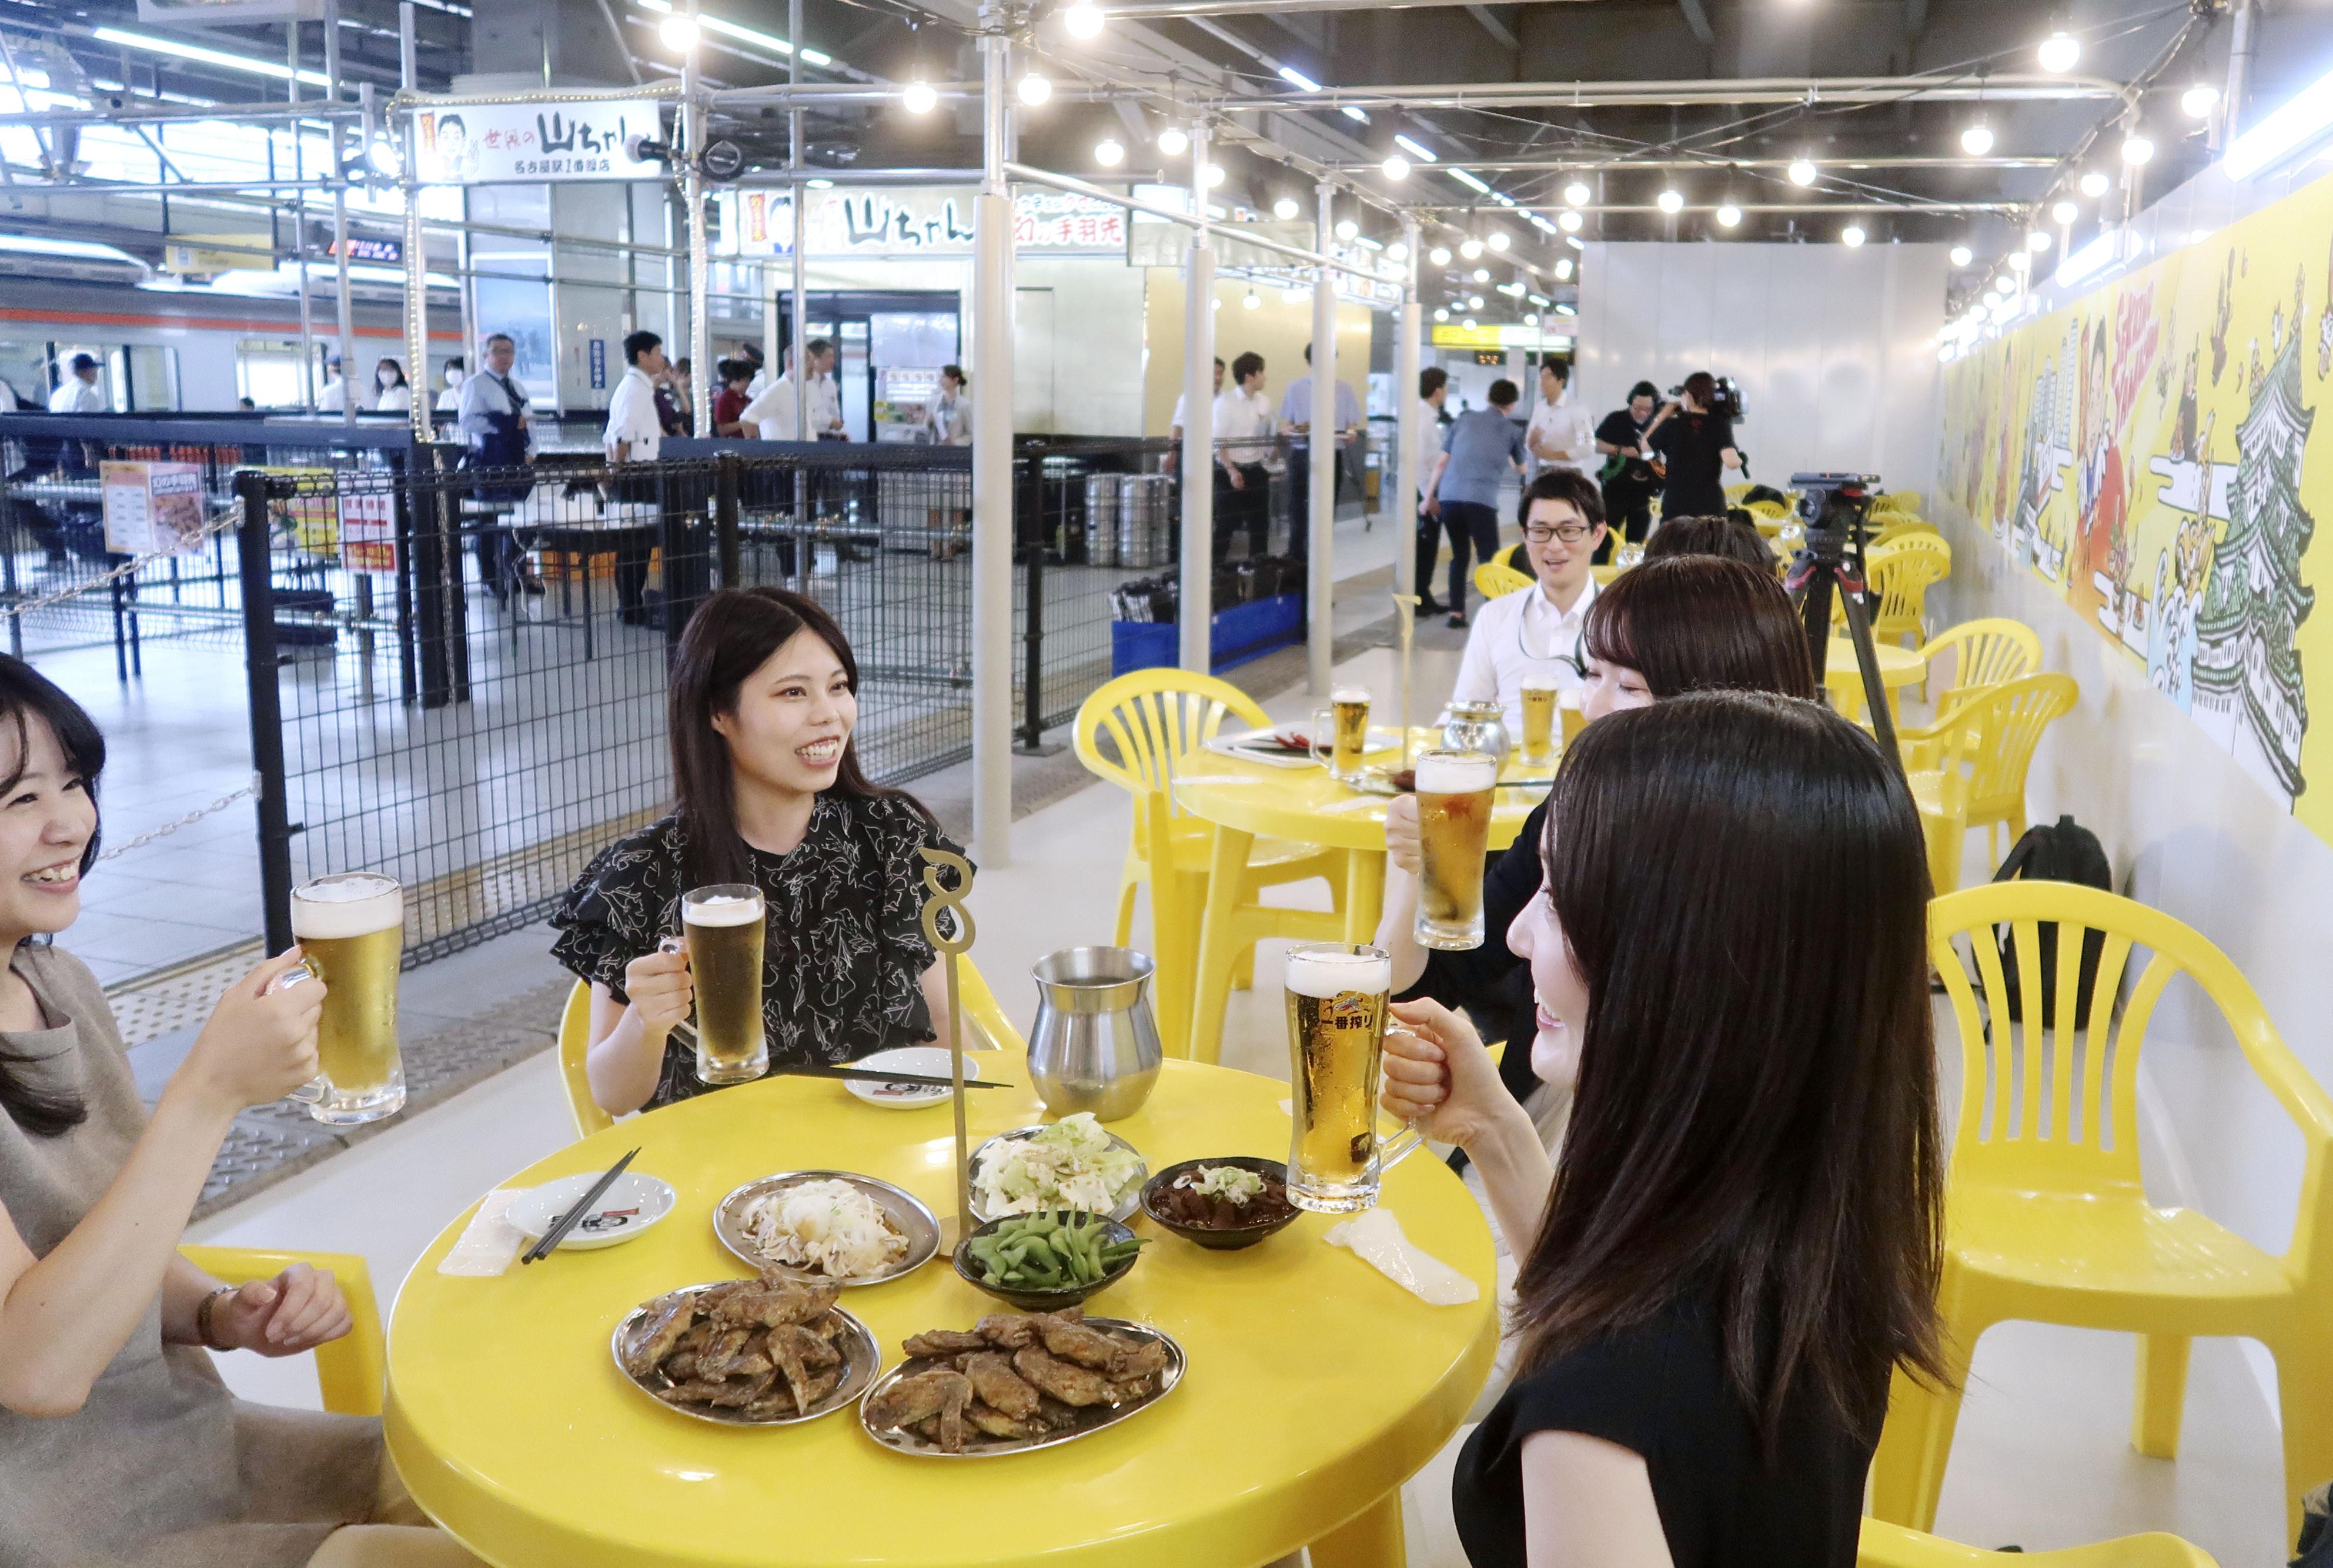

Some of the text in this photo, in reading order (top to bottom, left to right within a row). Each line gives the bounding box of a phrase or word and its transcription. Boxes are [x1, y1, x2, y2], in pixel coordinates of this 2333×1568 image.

[918, 847, 976, 954] 8
[1321, 1015, 1373, 1029] 一番搾り
